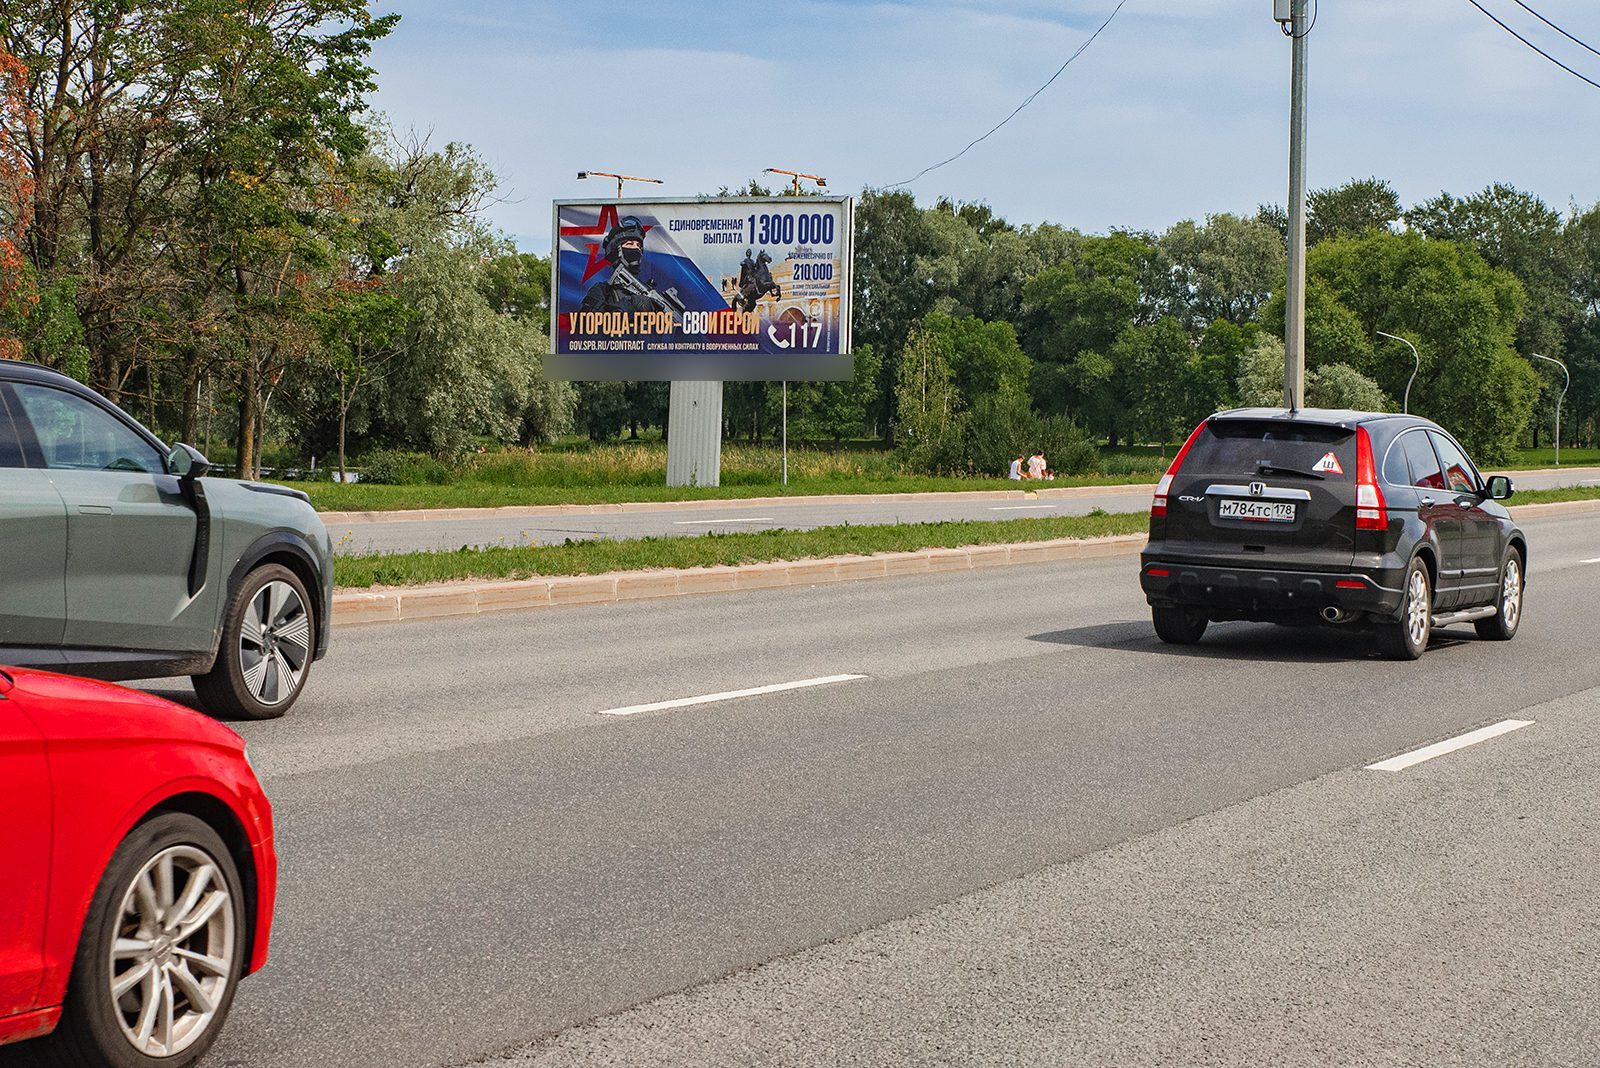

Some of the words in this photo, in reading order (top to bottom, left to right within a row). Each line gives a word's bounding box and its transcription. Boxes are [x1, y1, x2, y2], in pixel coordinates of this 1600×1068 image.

[669, 219, 743, 232] ЕДИНОВРЕМЕННАЯ
[703, 232, 743, 245] ВЫПЛАТА
[569, 311, 578, 335] У
[682, 310, 717, 335] СВОИ
[719, 310, 761, 335] ГЕРОИ
[788, 321, 823, 348] 117
[569, 340, 645, 351] GOV.SPB.RU/CONTRACT
[1273, 504, 1292, 515] 178
